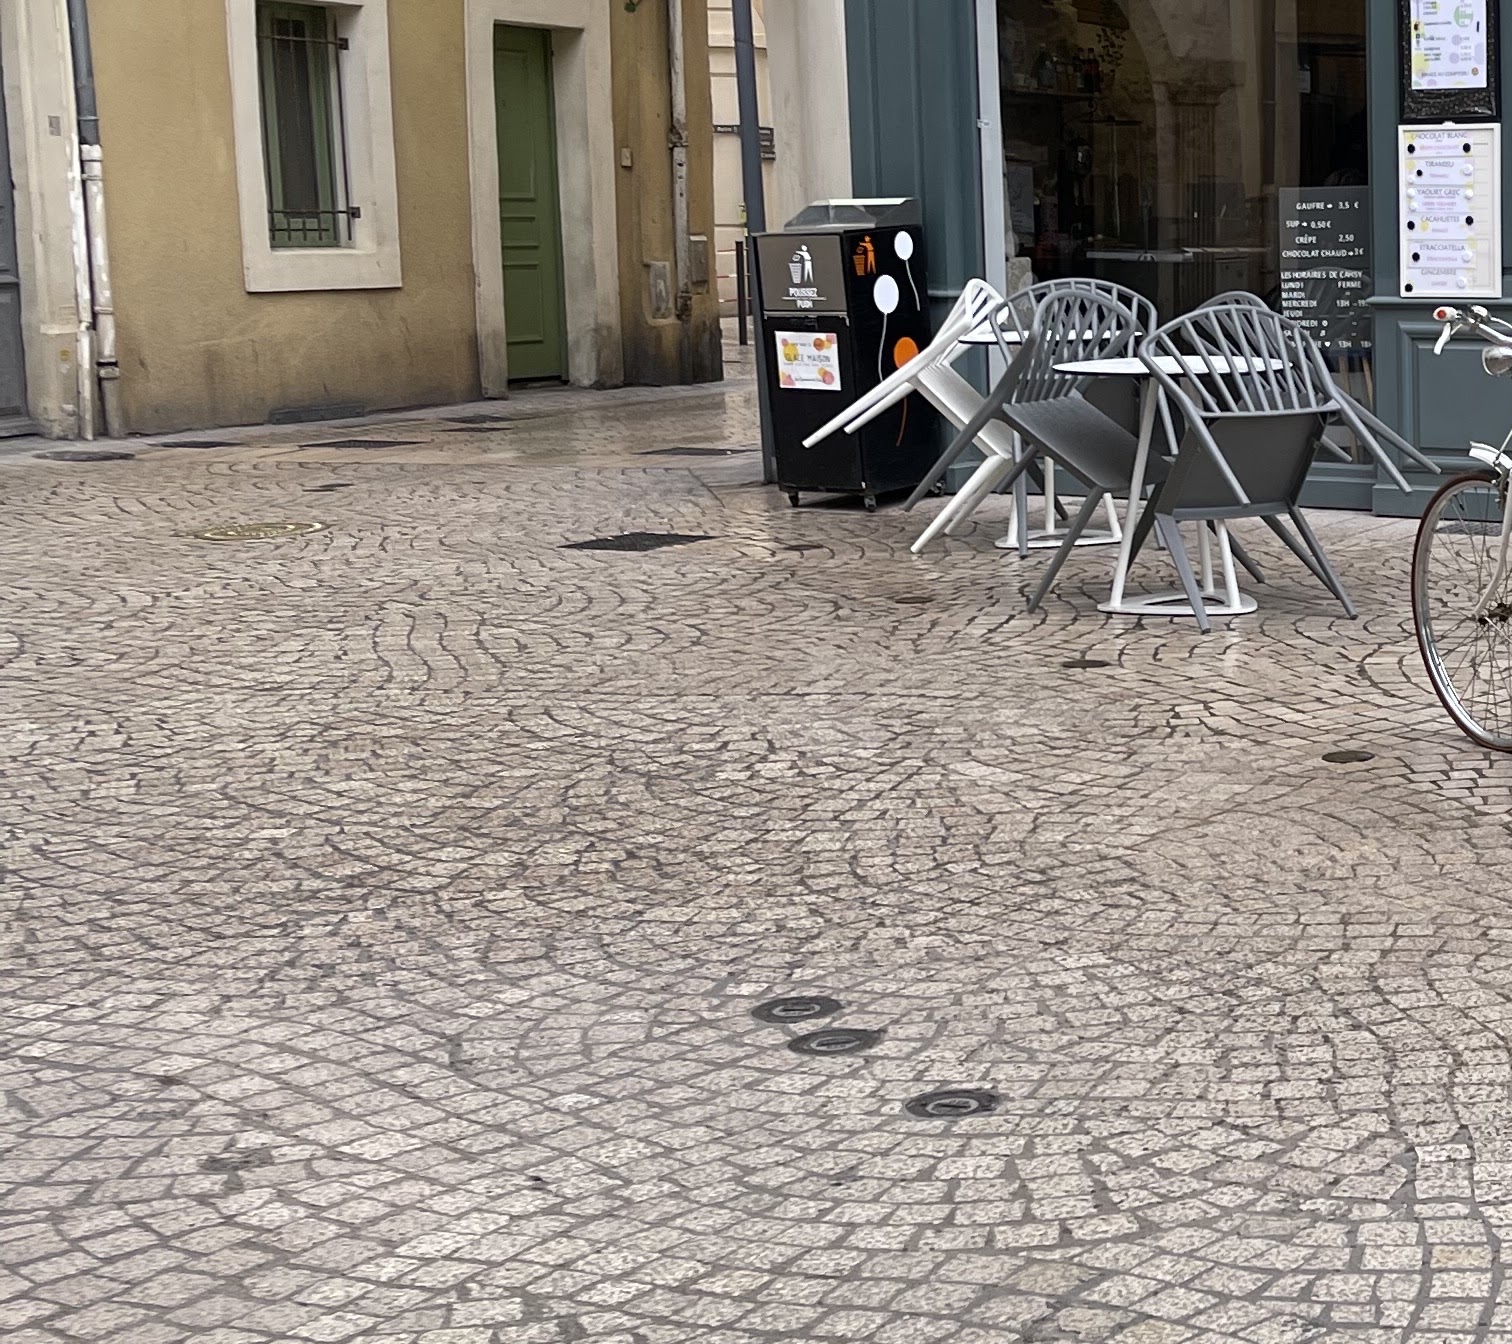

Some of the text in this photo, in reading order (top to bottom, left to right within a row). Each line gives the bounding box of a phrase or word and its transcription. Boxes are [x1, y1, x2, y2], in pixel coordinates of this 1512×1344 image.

[1296, 202, 1324, 210] GAUFRE
[1286, 220, 1300, 228] SUP
[1321, 249, 1347, 257] CHAUD
[1281, 271, 1292, 279] LES
[1292, 271, 1326, 279] HORAIRES
[1329, 271, 1338, 279] DE
